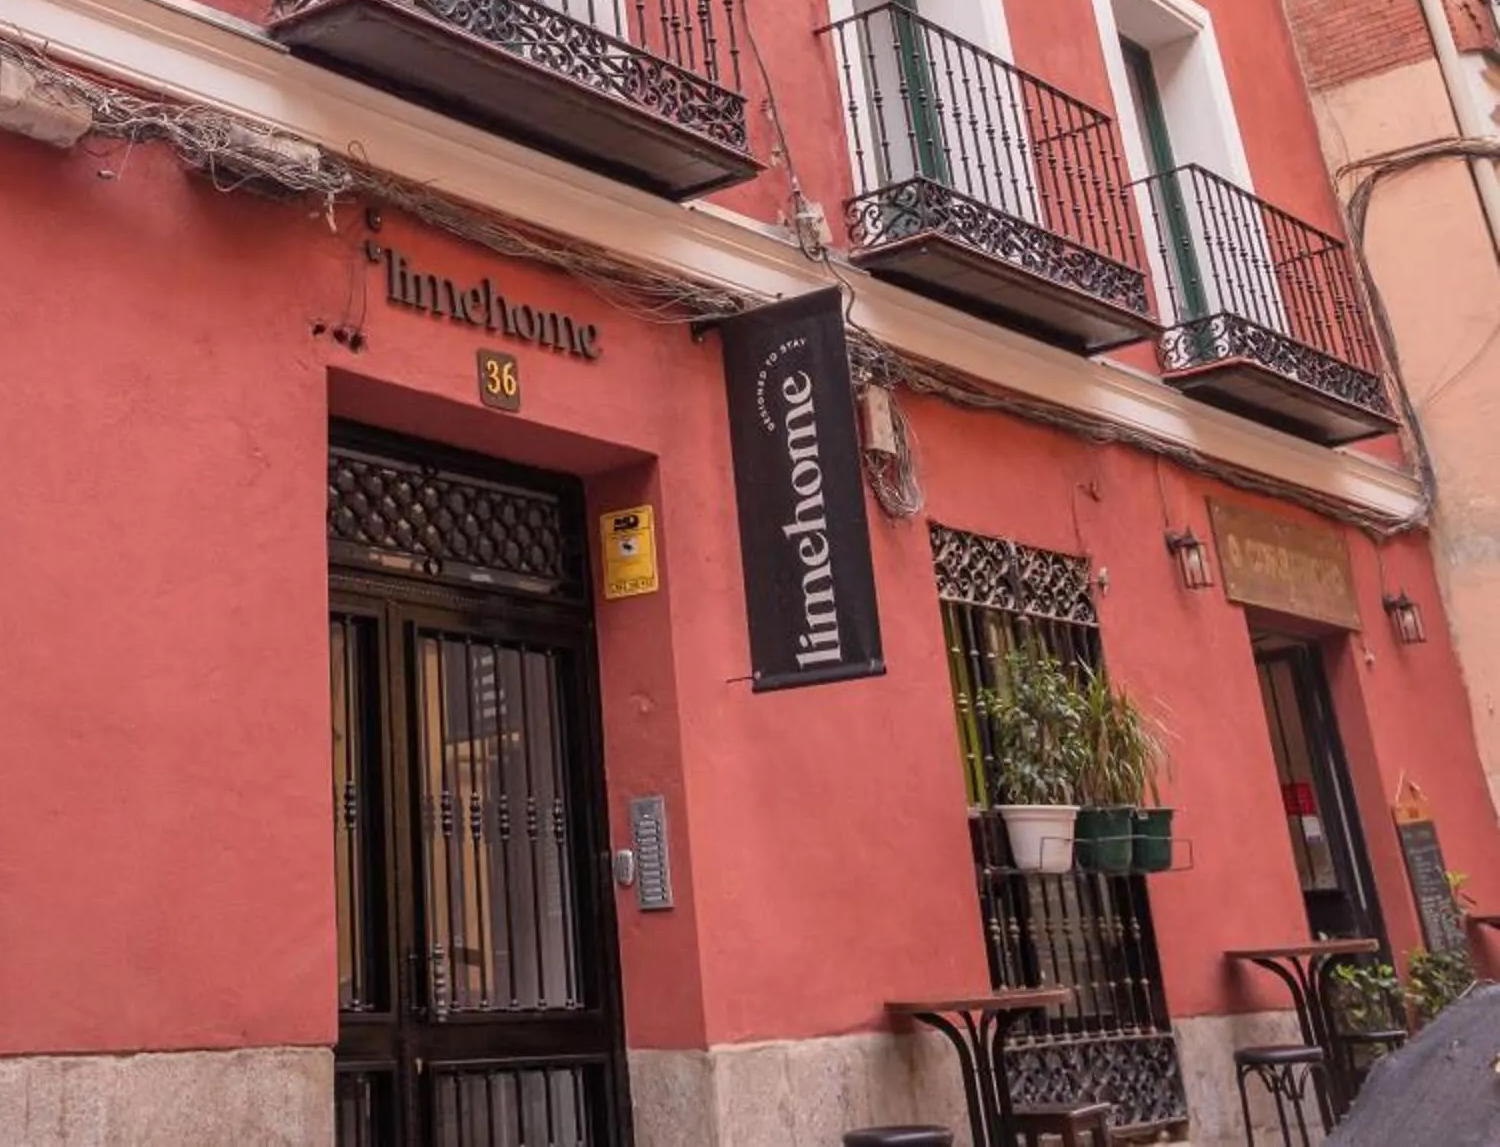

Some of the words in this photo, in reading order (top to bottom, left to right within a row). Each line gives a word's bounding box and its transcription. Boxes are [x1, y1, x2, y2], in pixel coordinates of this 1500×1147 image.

[384, 248, 602, 361] limehome
[486, 360, 517, 396] 36
[781, 370, 842, 670] limehome
